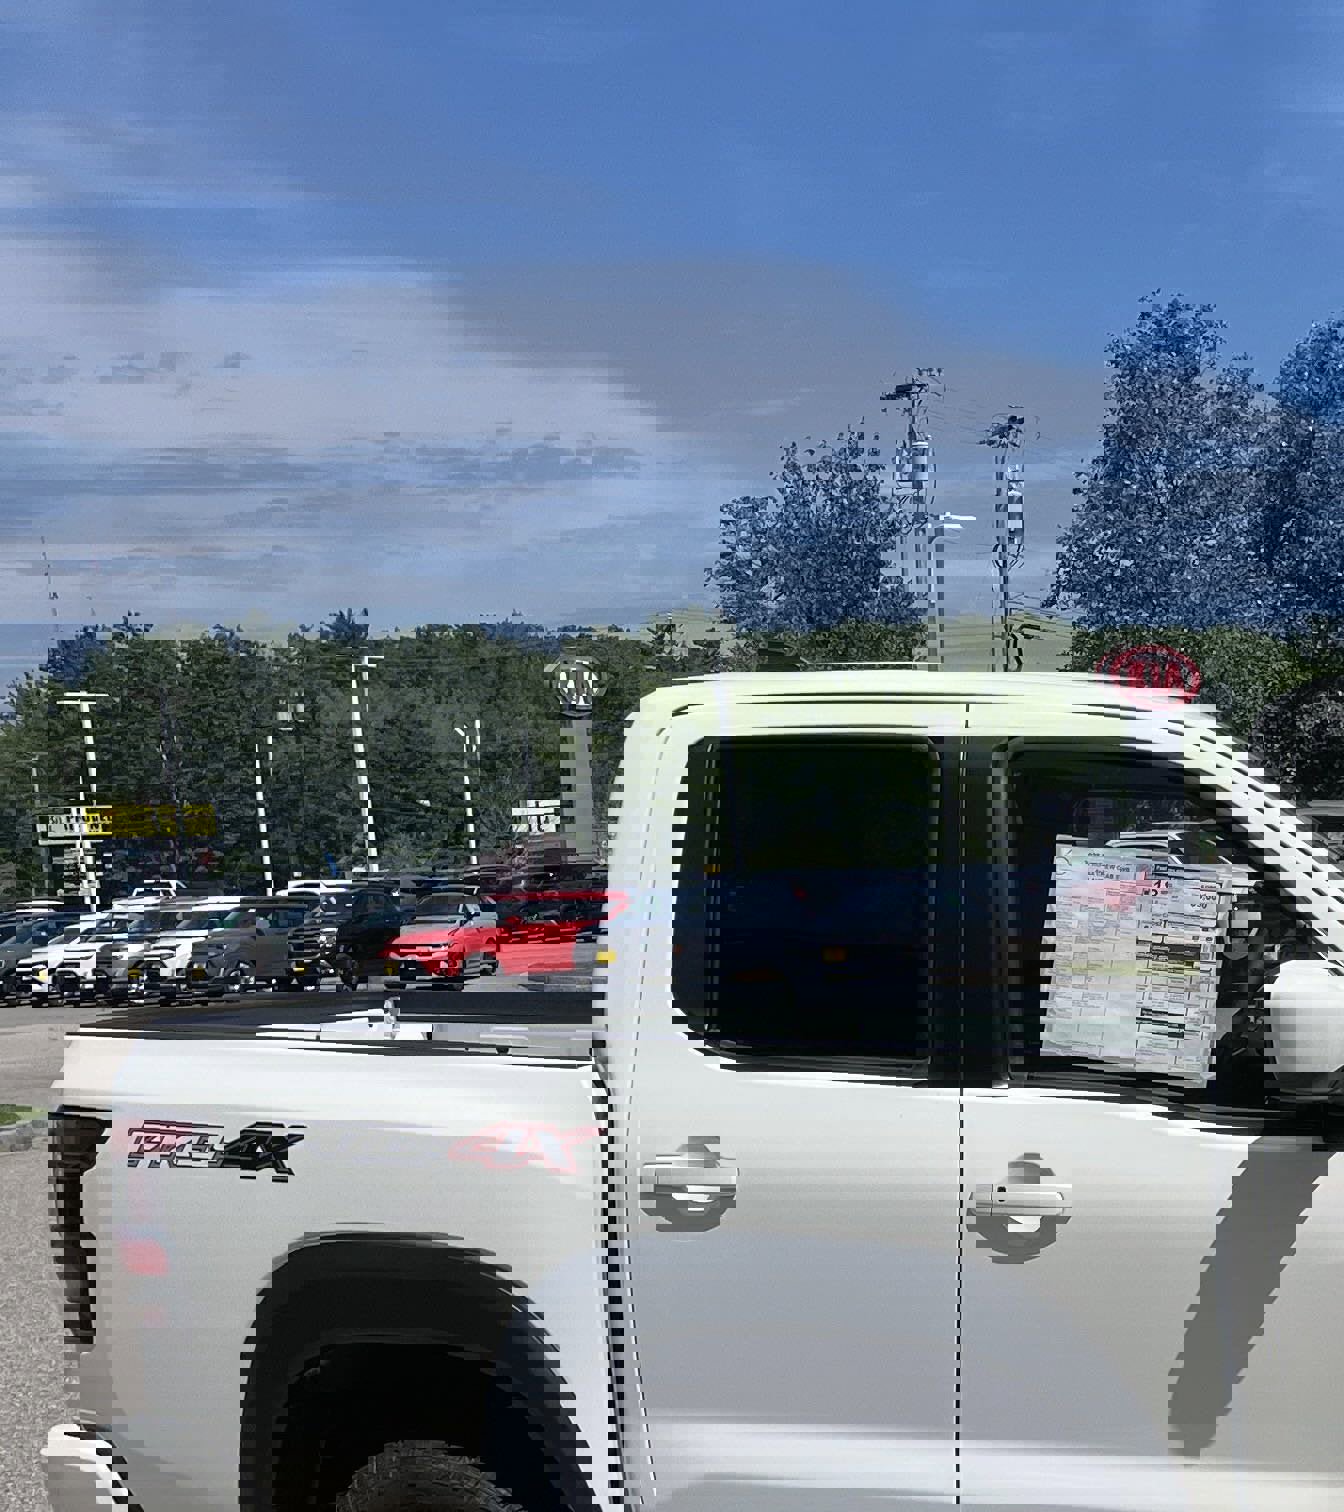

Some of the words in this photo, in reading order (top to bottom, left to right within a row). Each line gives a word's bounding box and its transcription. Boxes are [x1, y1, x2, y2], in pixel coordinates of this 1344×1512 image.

[1123, 659, 1187, 701] KIA
[129, 811, 212, 823] PR-ONED
[133, 823, 168, 832] SUPR
[170, 822, 211, 832] CNTER
